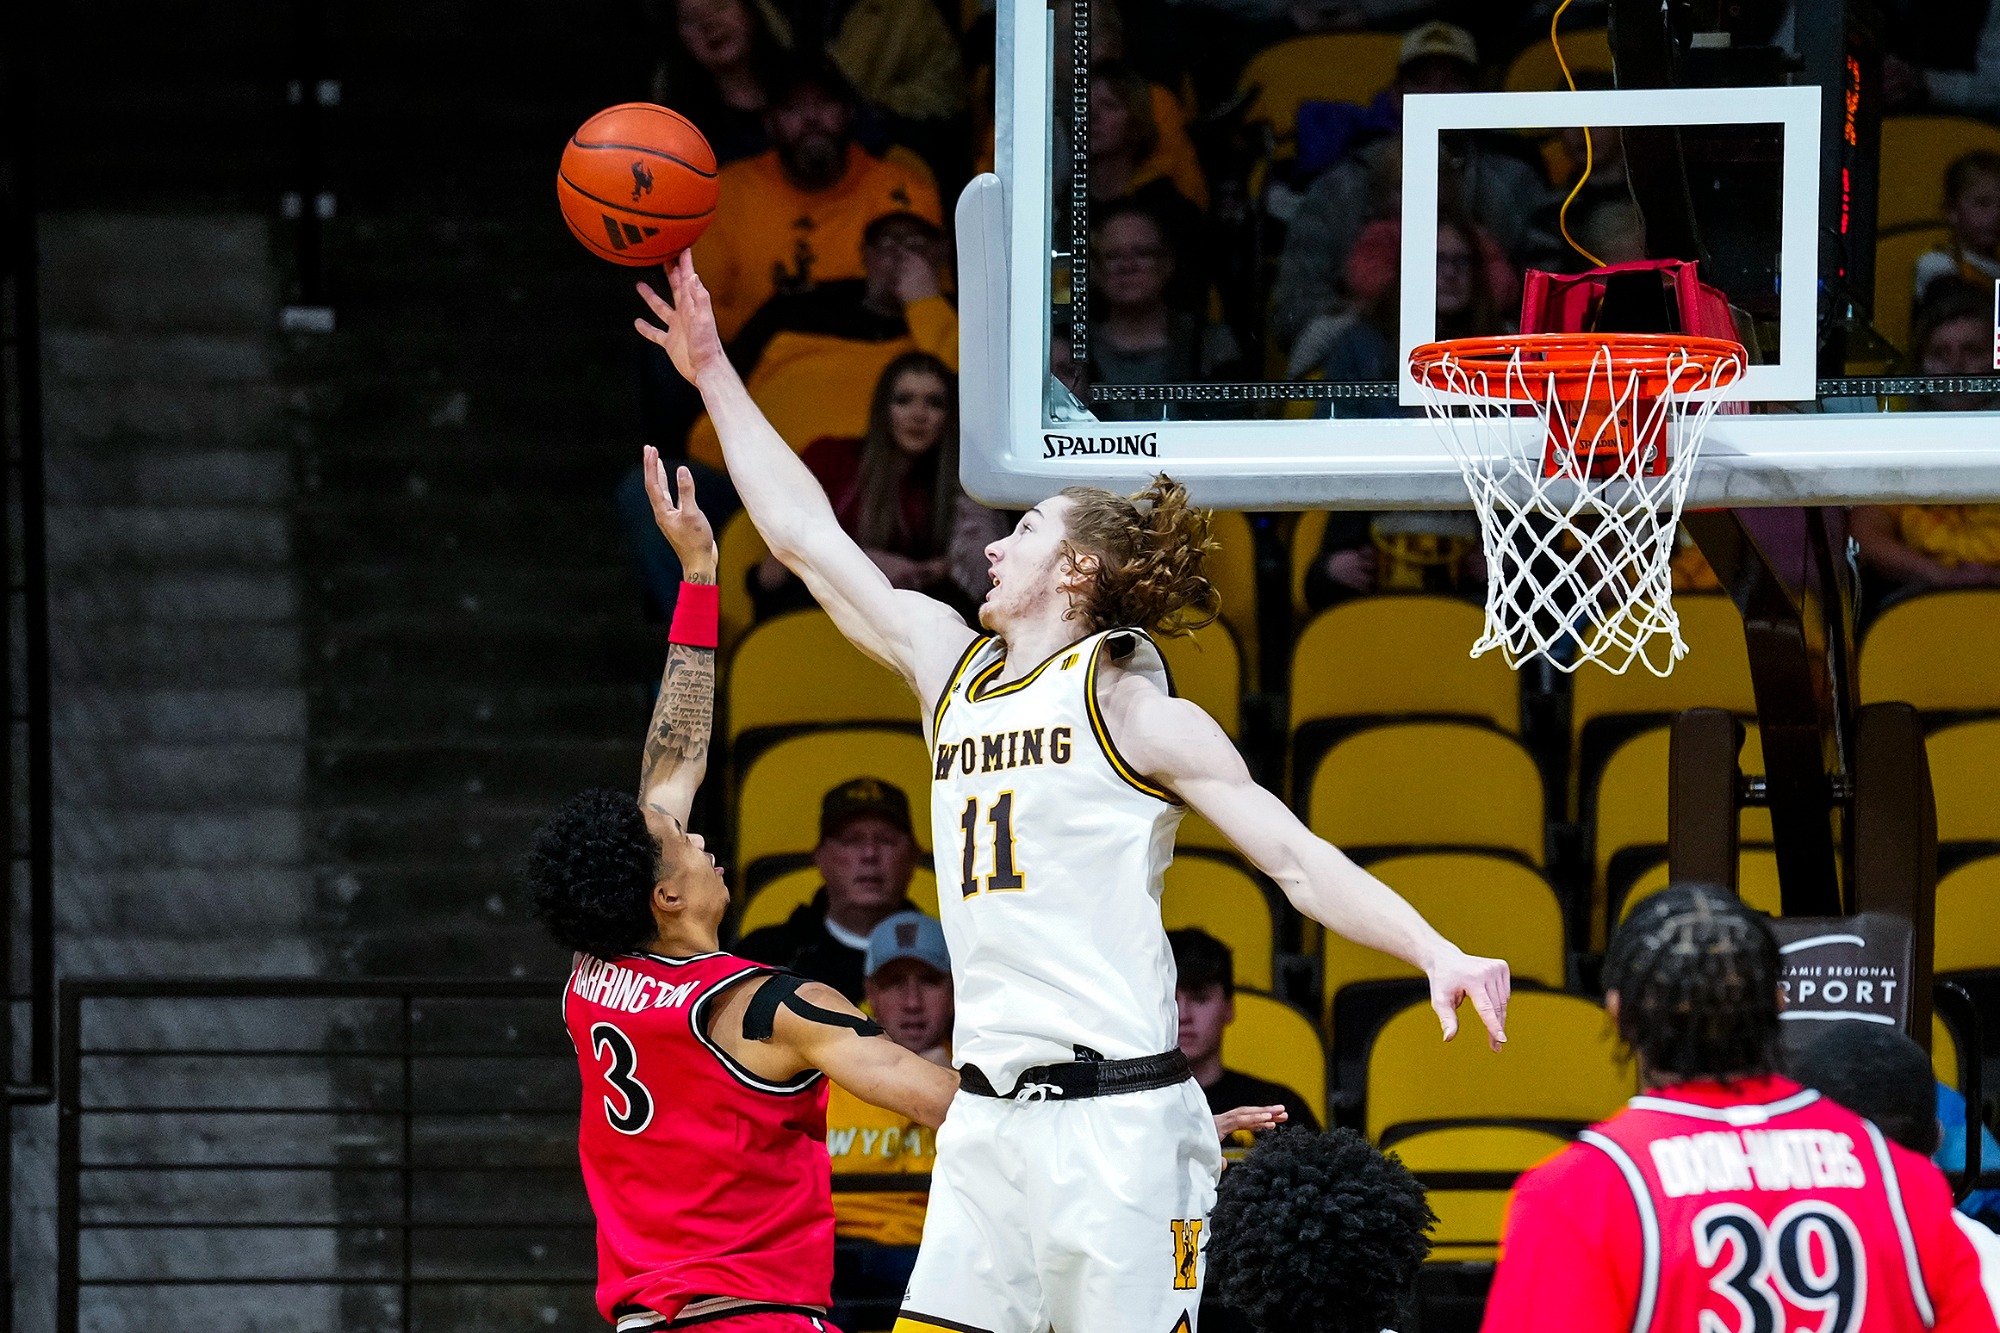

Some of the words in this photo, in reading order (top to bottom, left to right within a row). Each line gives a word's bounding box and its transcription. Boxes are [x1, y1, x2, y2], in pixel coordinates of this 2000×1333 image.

[1043, 432, 1158, 459] SPALDING
[1579, 438, 1624, 450] SPLDIN
[935, 727, 1072, 781] WOMING
[961, 789, 1025, 901] 11
[1827, 965, 1895, 977] REGIONAL
[1777, 980, 1897, 1004] RPORT
[590, 1021, 655, 1135] 3
[1691, 1199, 1868, 1333] 39
